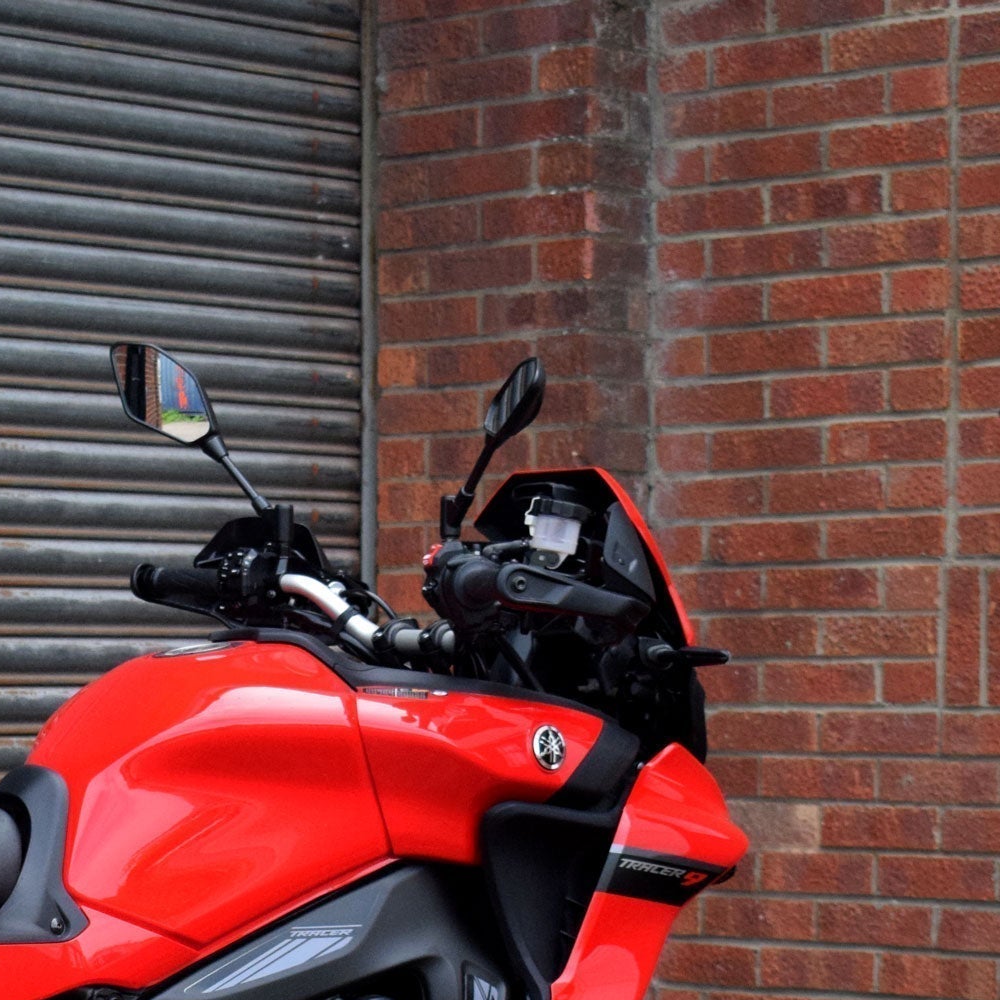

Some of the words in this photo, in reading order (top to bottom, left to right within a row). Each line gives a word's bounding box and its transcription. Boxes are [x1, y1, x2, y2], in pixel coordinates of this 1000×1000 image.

[619, 858, 687, 879] TRACER
[681, 871, 708, 887] 9
[289, 928, 354, 938] TRACER
